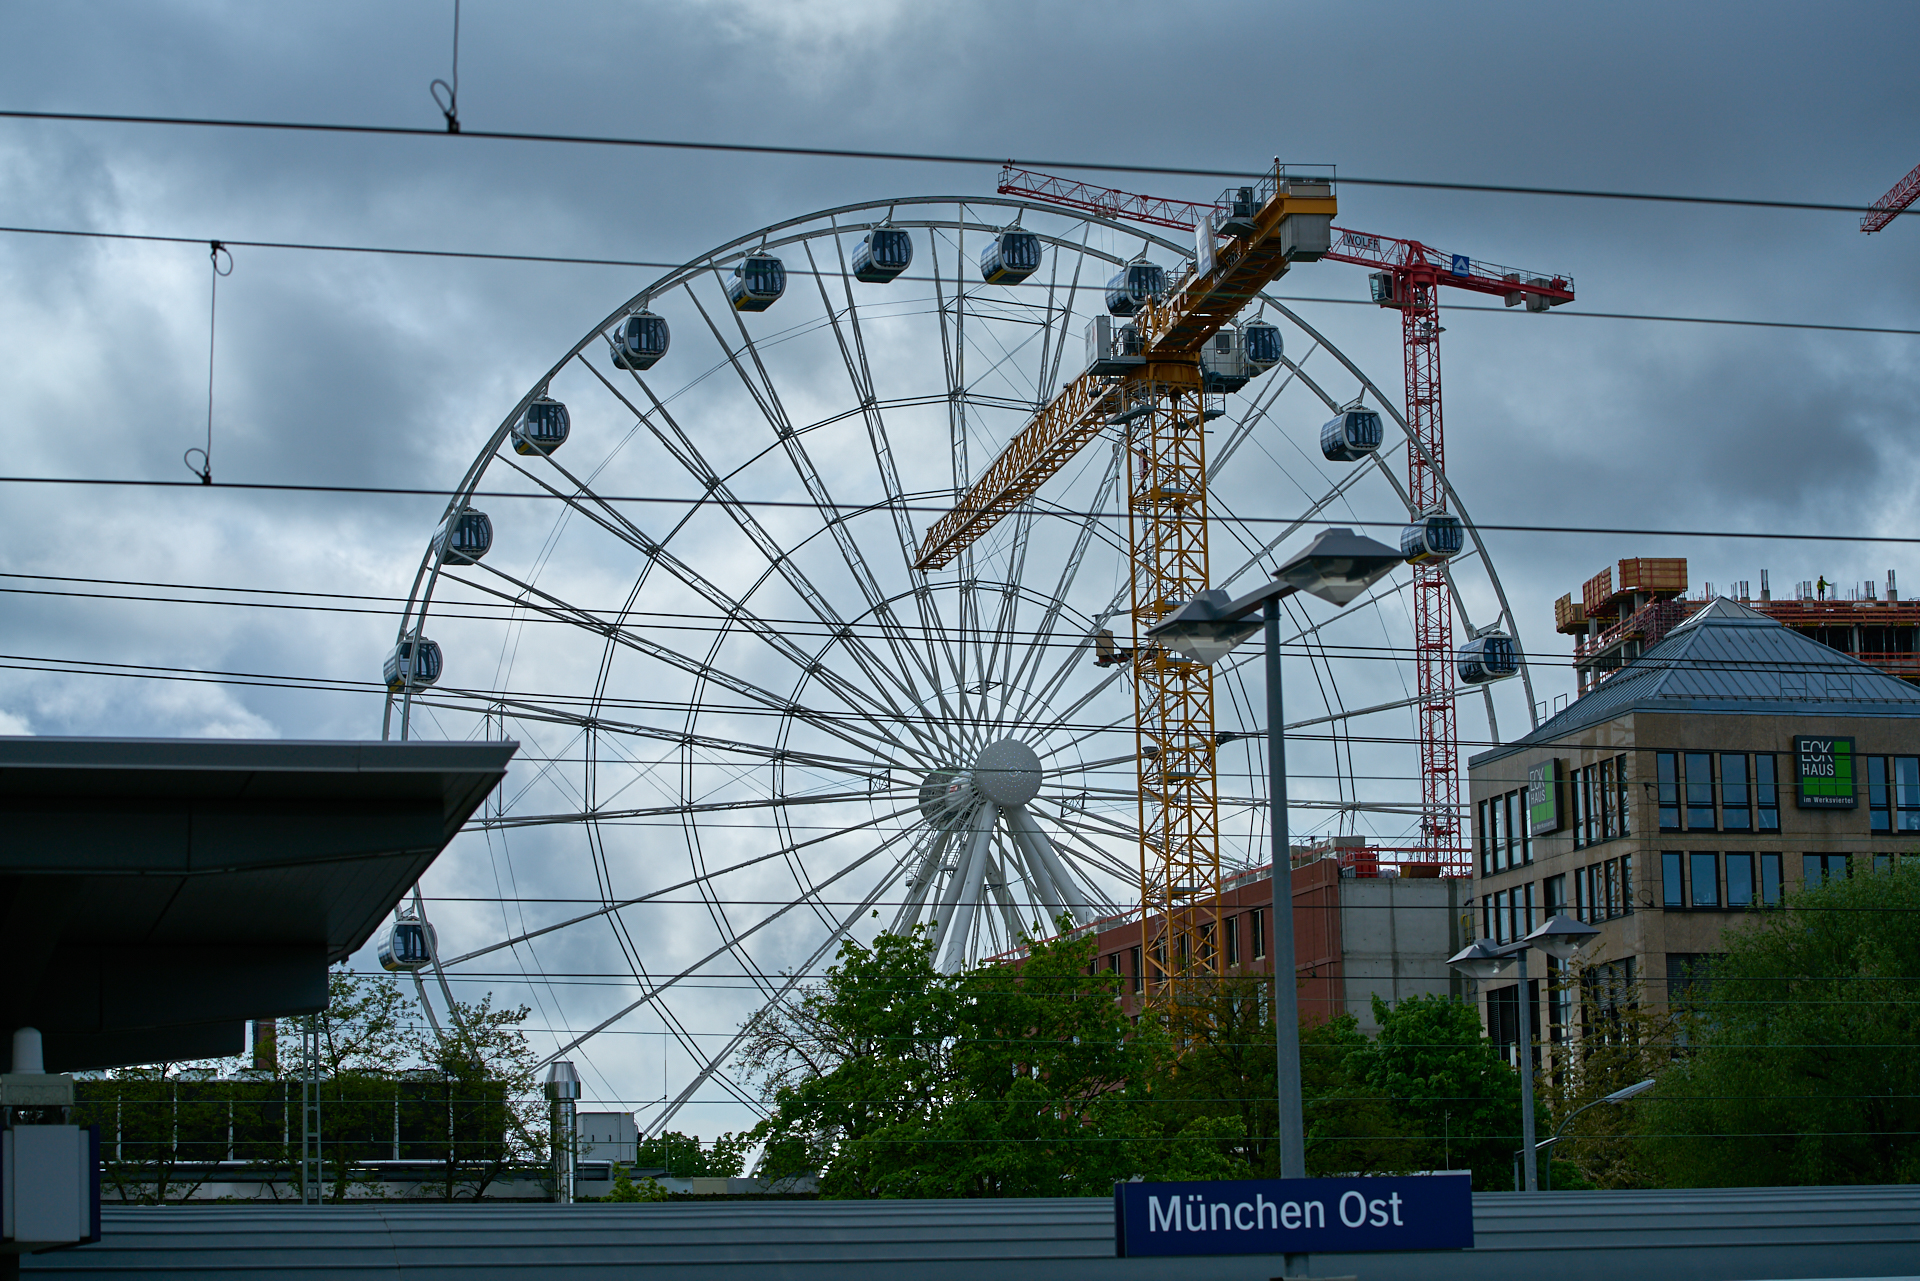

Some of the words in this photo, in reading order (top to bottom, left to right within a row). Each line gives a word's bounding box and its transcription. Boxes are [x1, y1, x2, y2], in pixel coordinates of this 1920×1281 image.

[1346, 234, 1378, 249] WOLFF
[1801, 741, 1832, 762] ECK
[1802, 763, 1834, 776] HAUS
[1529, 767, 1545, 791] ECK
[1530, 789, 1545, 805] HAUS
[1813, 796, 1853, 804] Werksviertel
[1149, 1194, 1325, 1232] München
[1339, 1190, 1403, 1228] Ost
